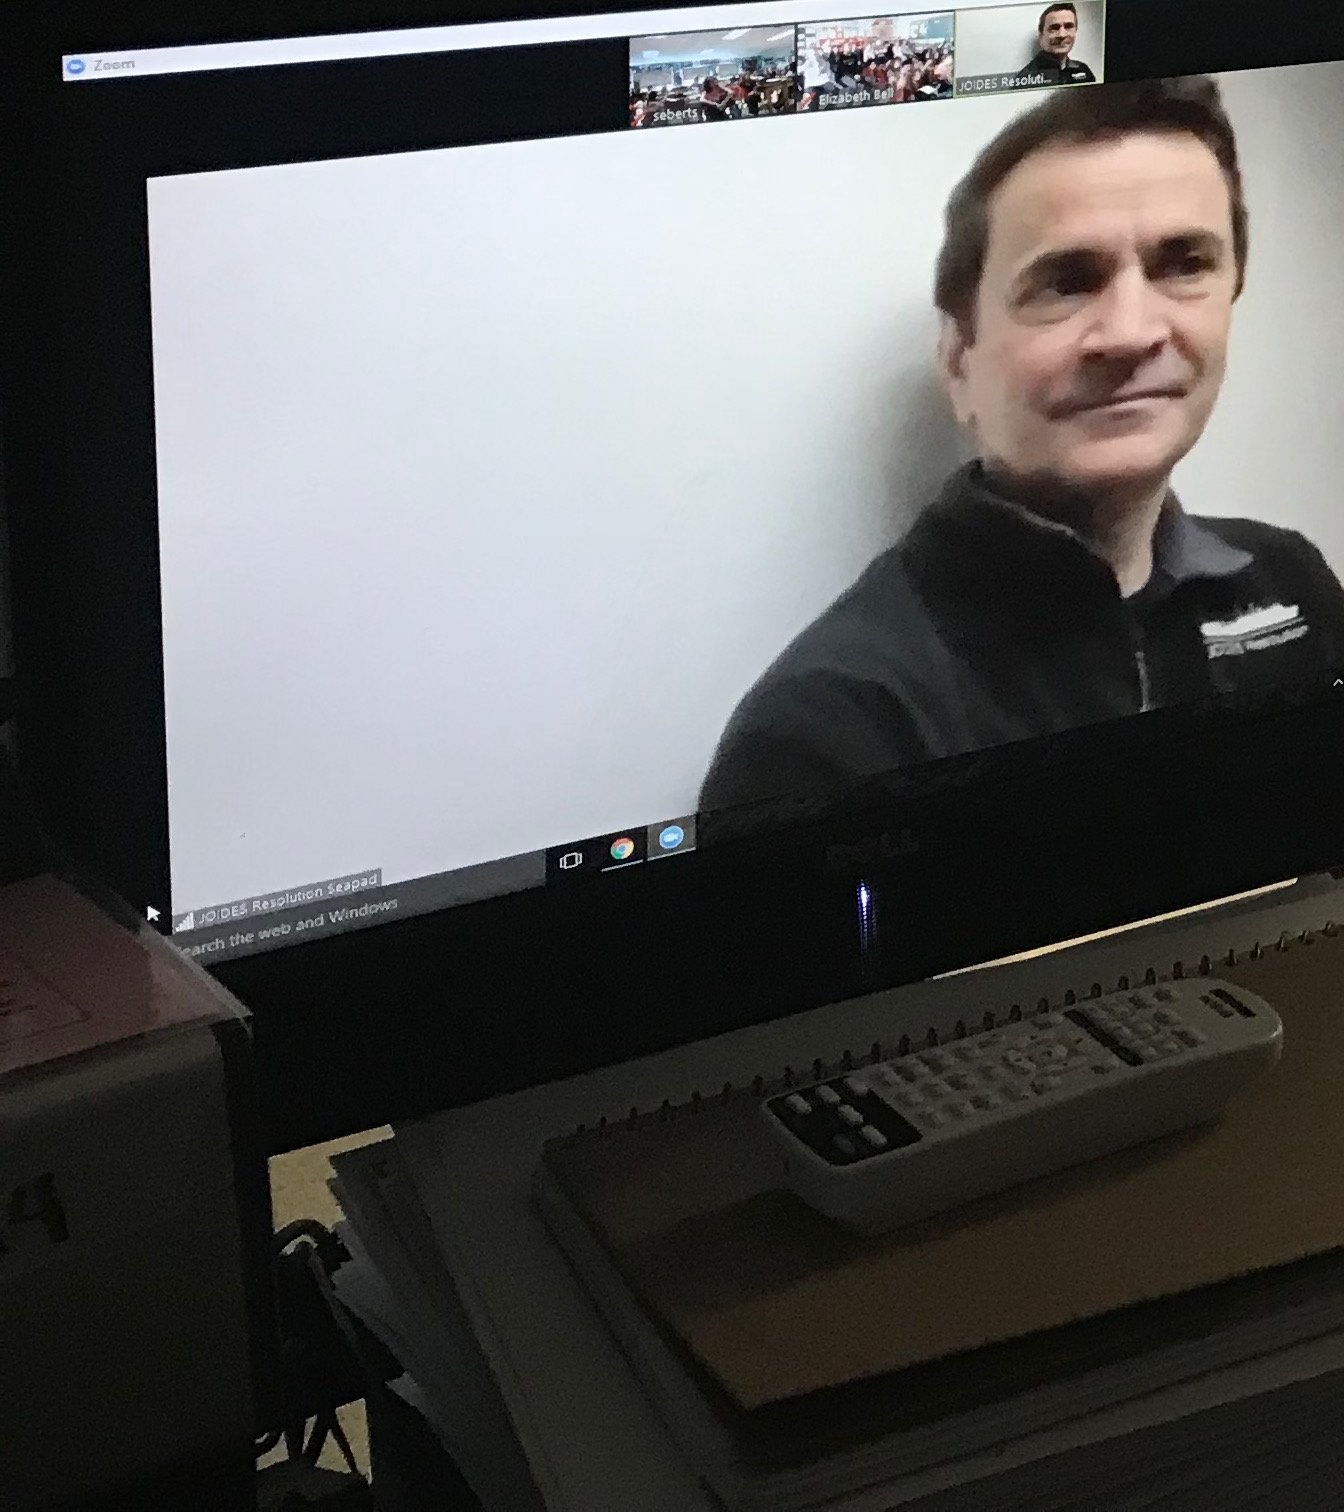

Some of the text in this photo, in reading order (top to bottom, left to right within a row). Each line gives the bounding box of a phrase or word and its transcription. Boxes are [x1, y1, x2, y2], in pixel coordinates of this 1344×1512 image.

[94, 59, 136, 72] Zoom
[958, 73, 1052, 92] JOIDES Resoluti...
[818, 87, 895, 106] Elizabeth Bell
[653, 107, 698, 123] seberts
[198, 873, 378, 925] JOIDES Resolution Seapad
[229, 932, 254, 947] the
[258, 923, 291, 940] web
[295, 913, 324, 931] and
[328, 898, 399, 924] Windows
